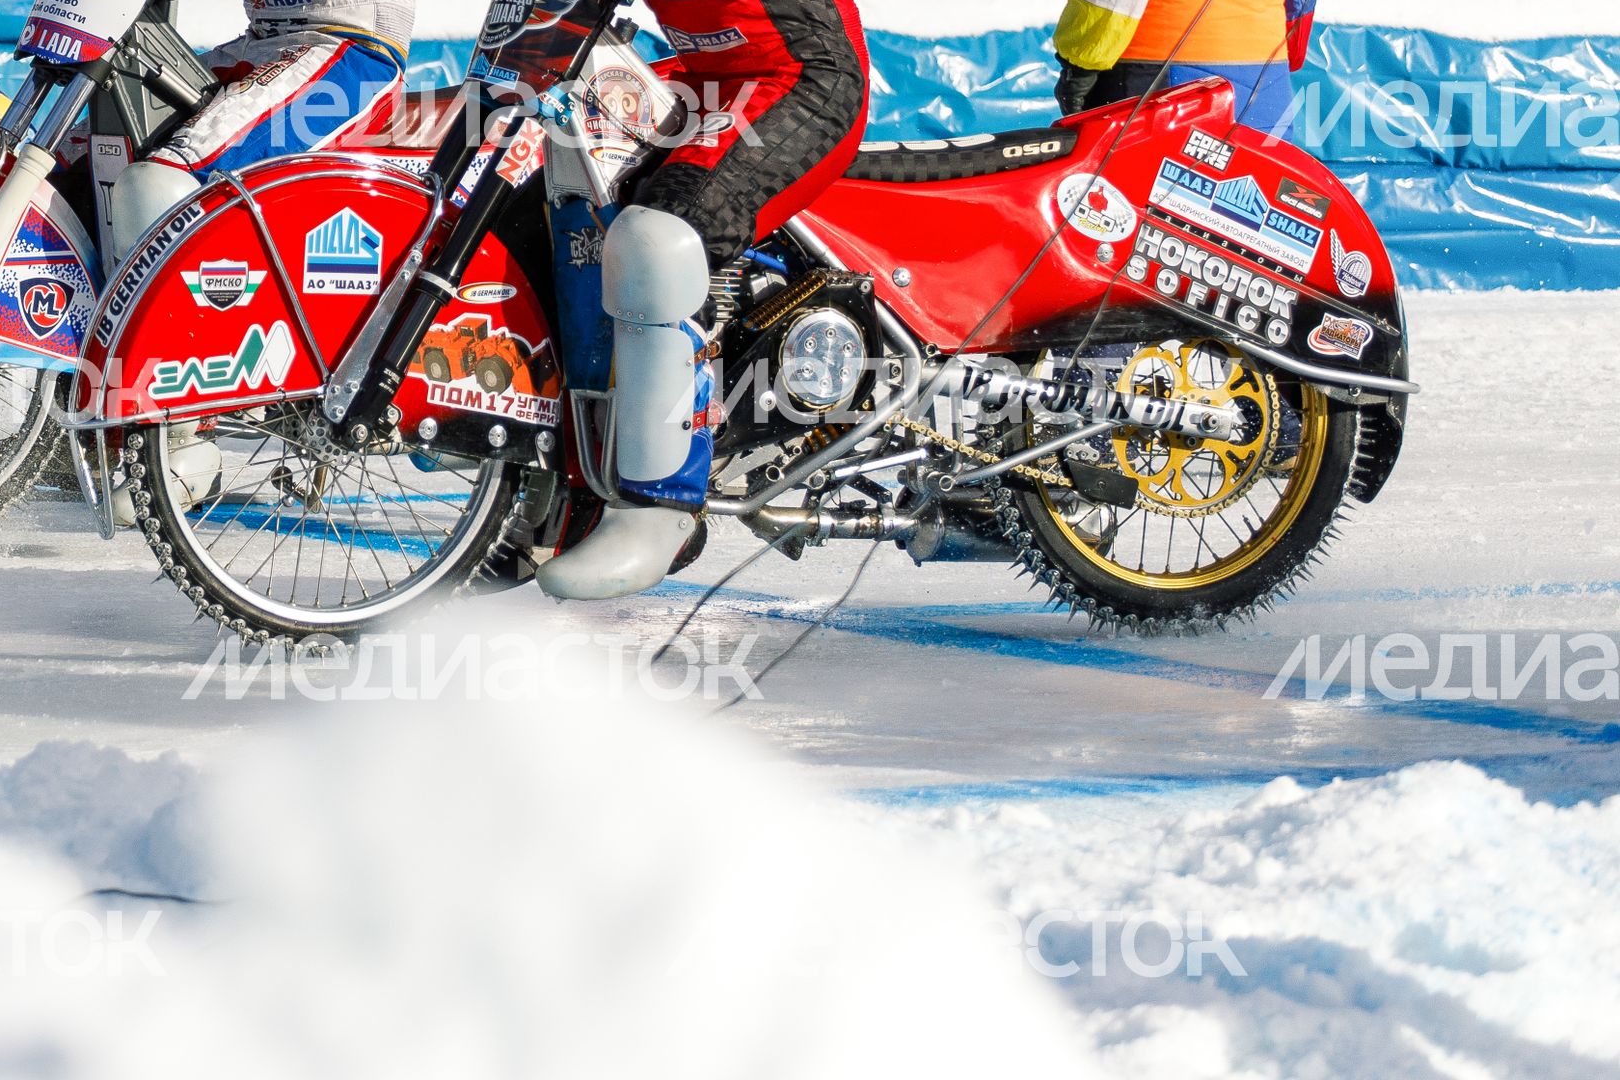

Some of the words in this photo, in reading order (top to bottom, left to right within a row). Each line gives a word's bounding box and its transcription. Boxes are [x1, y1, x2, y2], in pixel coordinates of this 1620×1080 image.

[43, 2, 87, 25] области
[490, 3, 525, 24] ШААЗ
[37, 29, 83, 61] LADA
[696, 31, 740, 48] SHAAZ
[498, 121, 545, 183] NGK
[1183, 143, 1230, 171] MTRS
[1188, 130, 1235, 157] COOL
[1162, 163, 1214, 197] ШААЗ
[1221, 222, 1280, 256] АВТОАГРЕГАТНЫЙ
[1267, 213, 1318, 245] SHAAZ
[97, 317, 115, 346] JB
[110, 229, 173, 316] GERMAN
[173, 204, 201, 234] OIL
[205, 278, 243, 288] ФМСКО
[307, 280, 326, 289] АО
[1136, 226, 1298, 320] НОКОЛОК
[477, 289, 501, 298] GERMAN
[501, 288, 512, 297] OIL
[1126, 255, 1290, 345] SOFICO
[1321, 328, 1362, 351] РАДИАТОРЫ
[516, 410, 559, 425] ФЕРРИ
